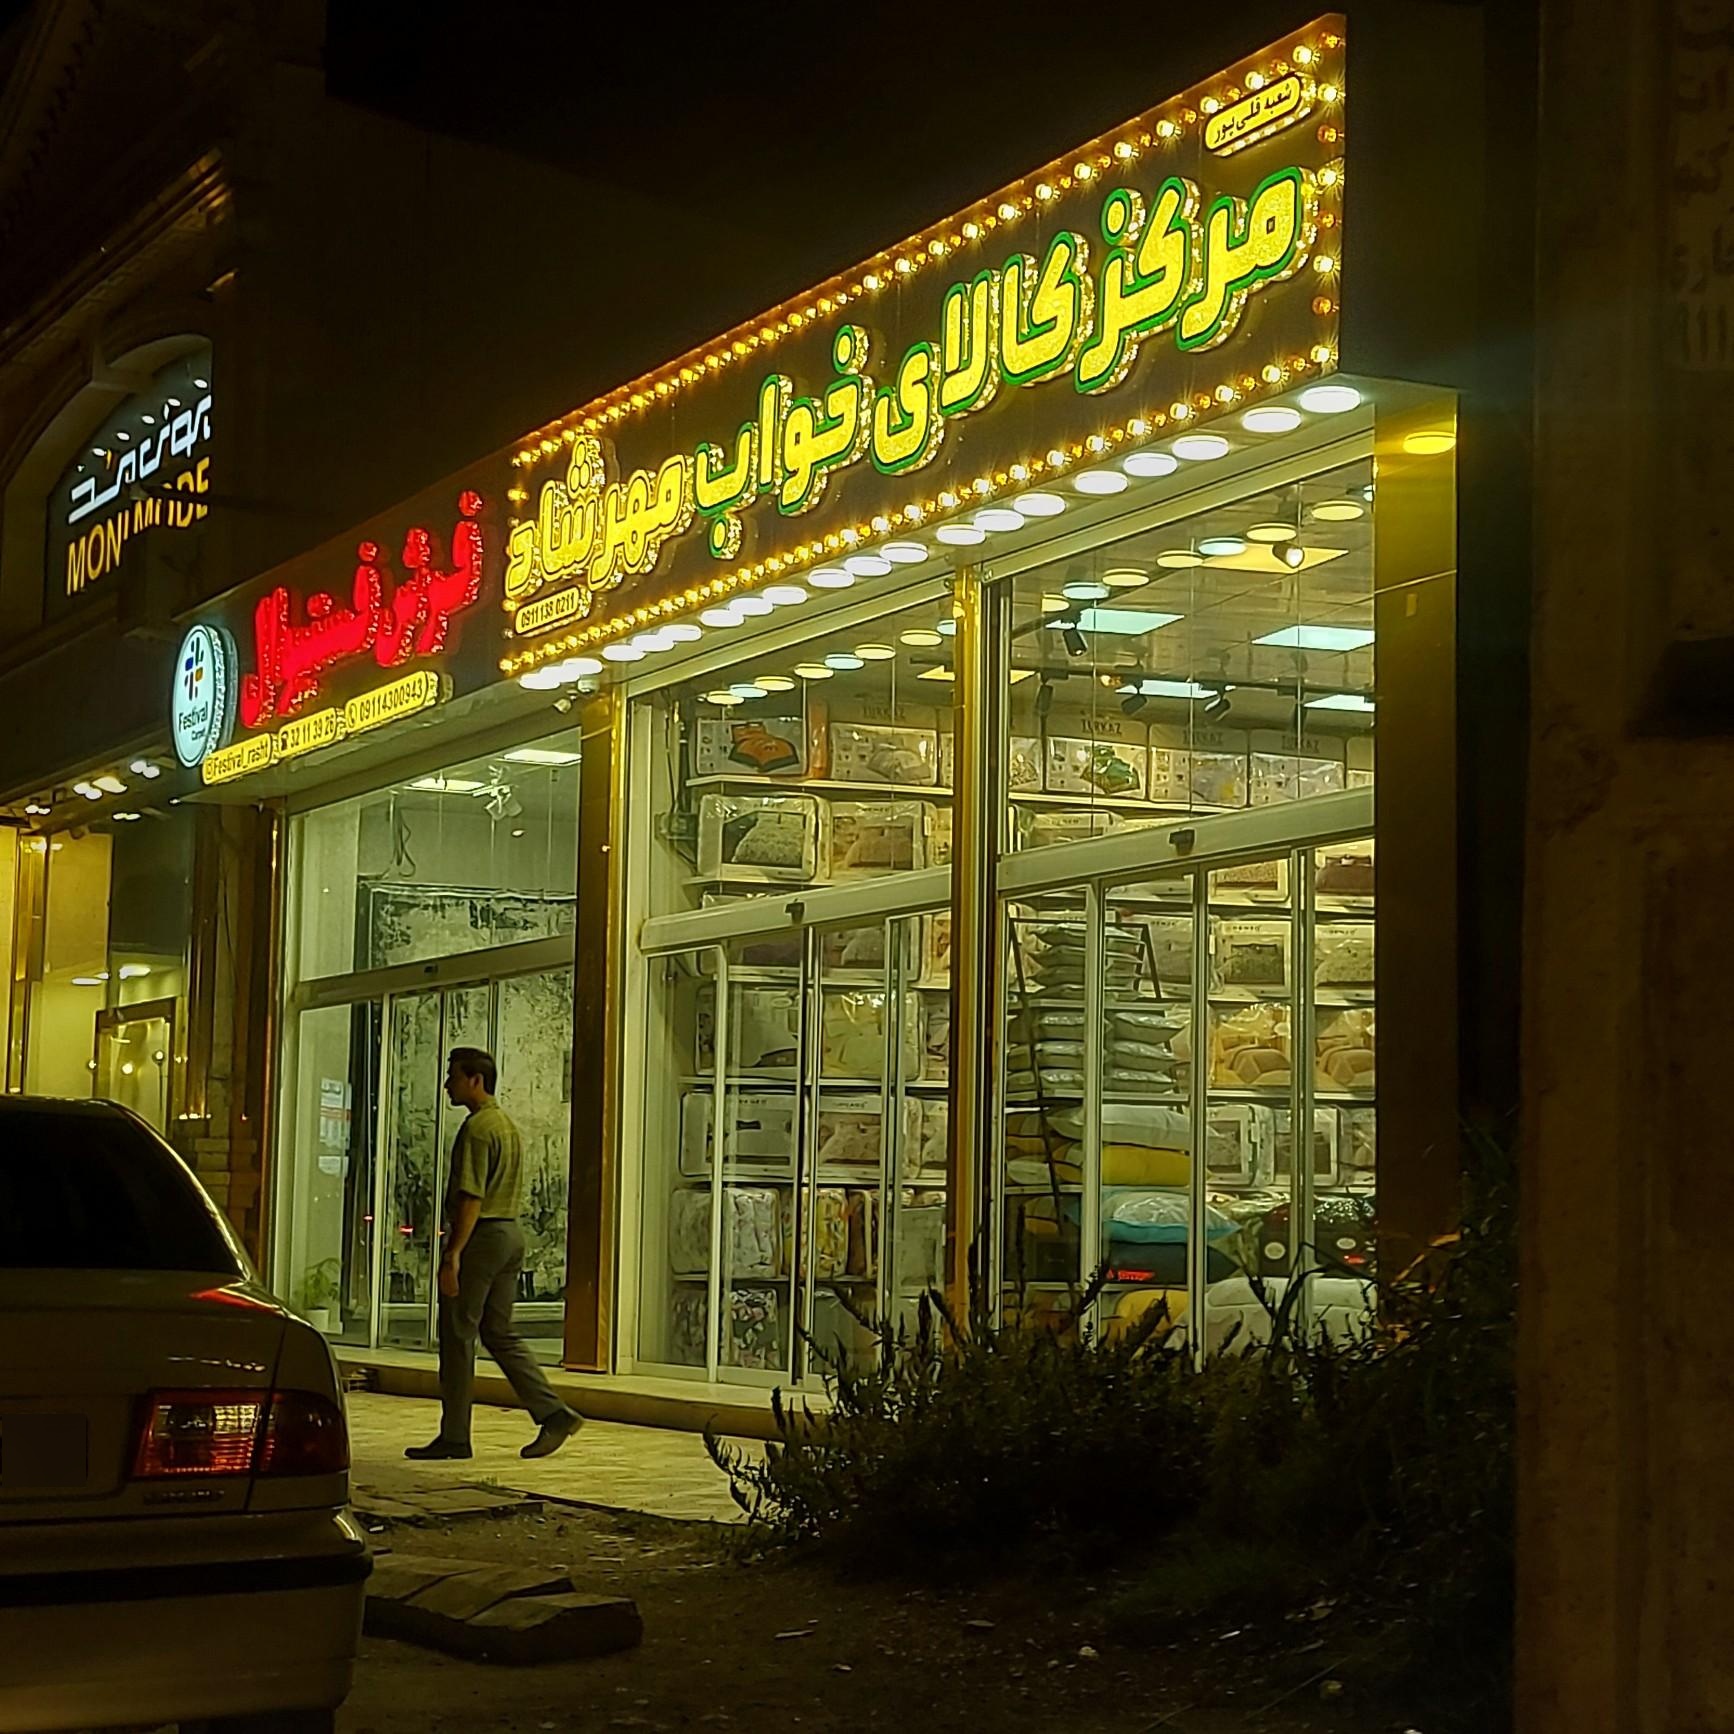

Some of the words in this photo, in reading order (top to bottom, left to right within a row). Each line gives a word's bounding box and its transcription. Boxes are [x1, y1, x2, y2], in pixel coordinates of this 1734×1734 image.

[1264, 84, 1292, 115] شعبه
[871, 232, 1092, 474] کالای
[1076, 167, 1310, 394] مرکز
[504, 439, 694, 599] مهرشاد
[695, 324, 870, 559] خواب
[240, 542, 379, 729] فستیوال
[375, 490, 483, 668] فرش
[178, 700, 209, 732] Festival
